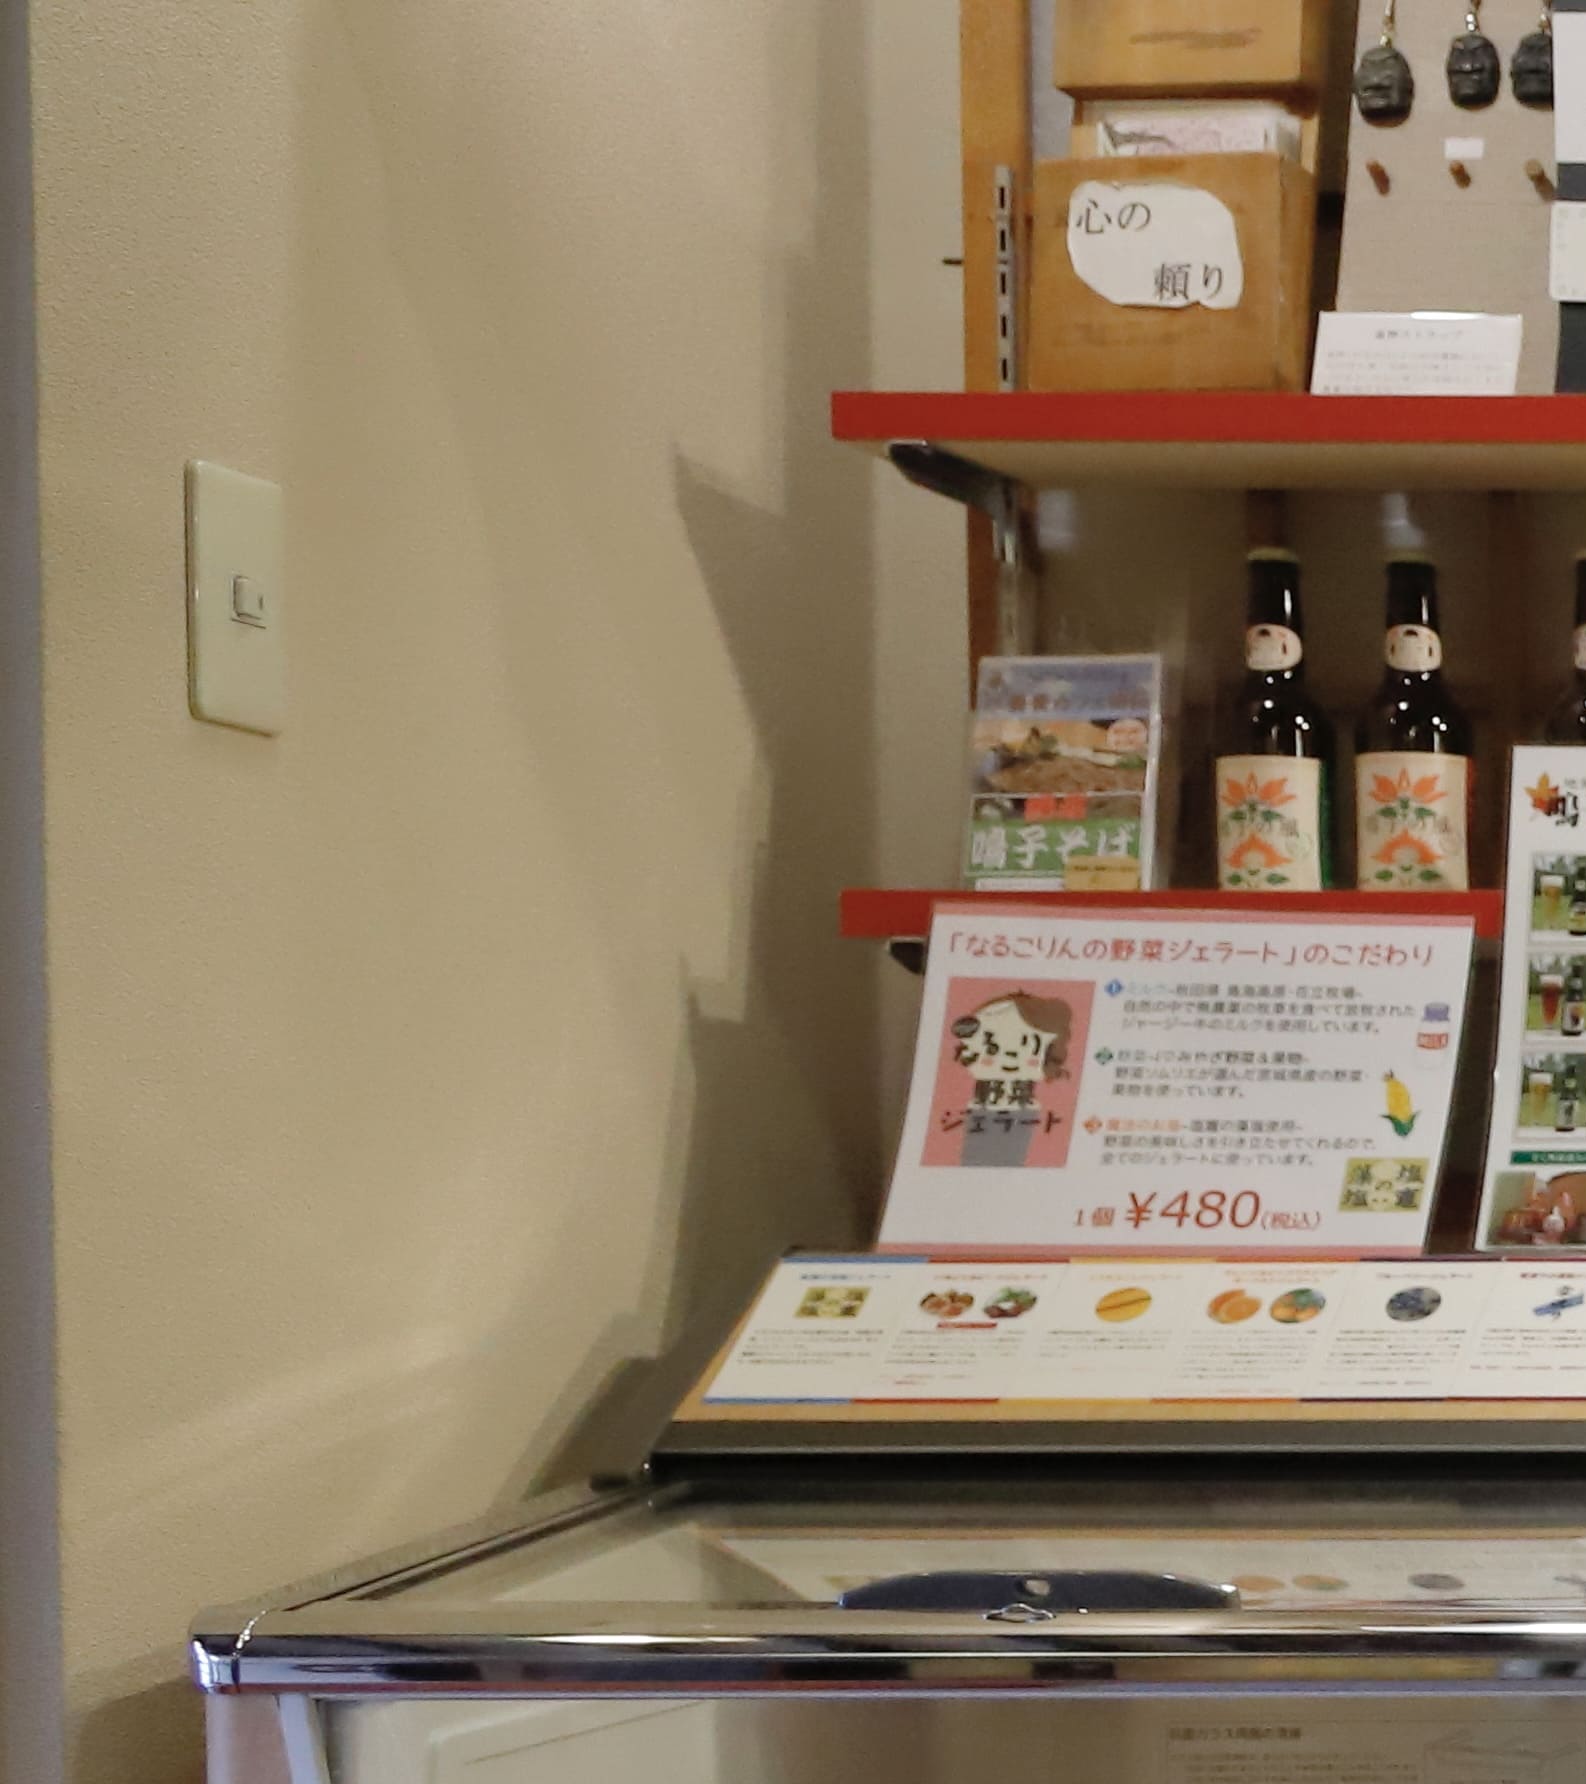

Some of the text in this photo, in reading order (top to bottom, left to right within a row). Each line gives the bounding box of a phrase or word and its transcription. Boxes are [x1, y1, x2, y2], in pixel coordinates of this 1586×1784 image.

[1076, 202, 1150, 234] 心の
[1154, 263, 1224, 299] 頼り
[970, 822, 1137, 869] 鳴子そば
[950, 933, 1434, 967] 「なるこりんの野菜ジェラート」のこだわり
[1074, 1191, 1320, 1231] 1個 ¥480 (税込)
